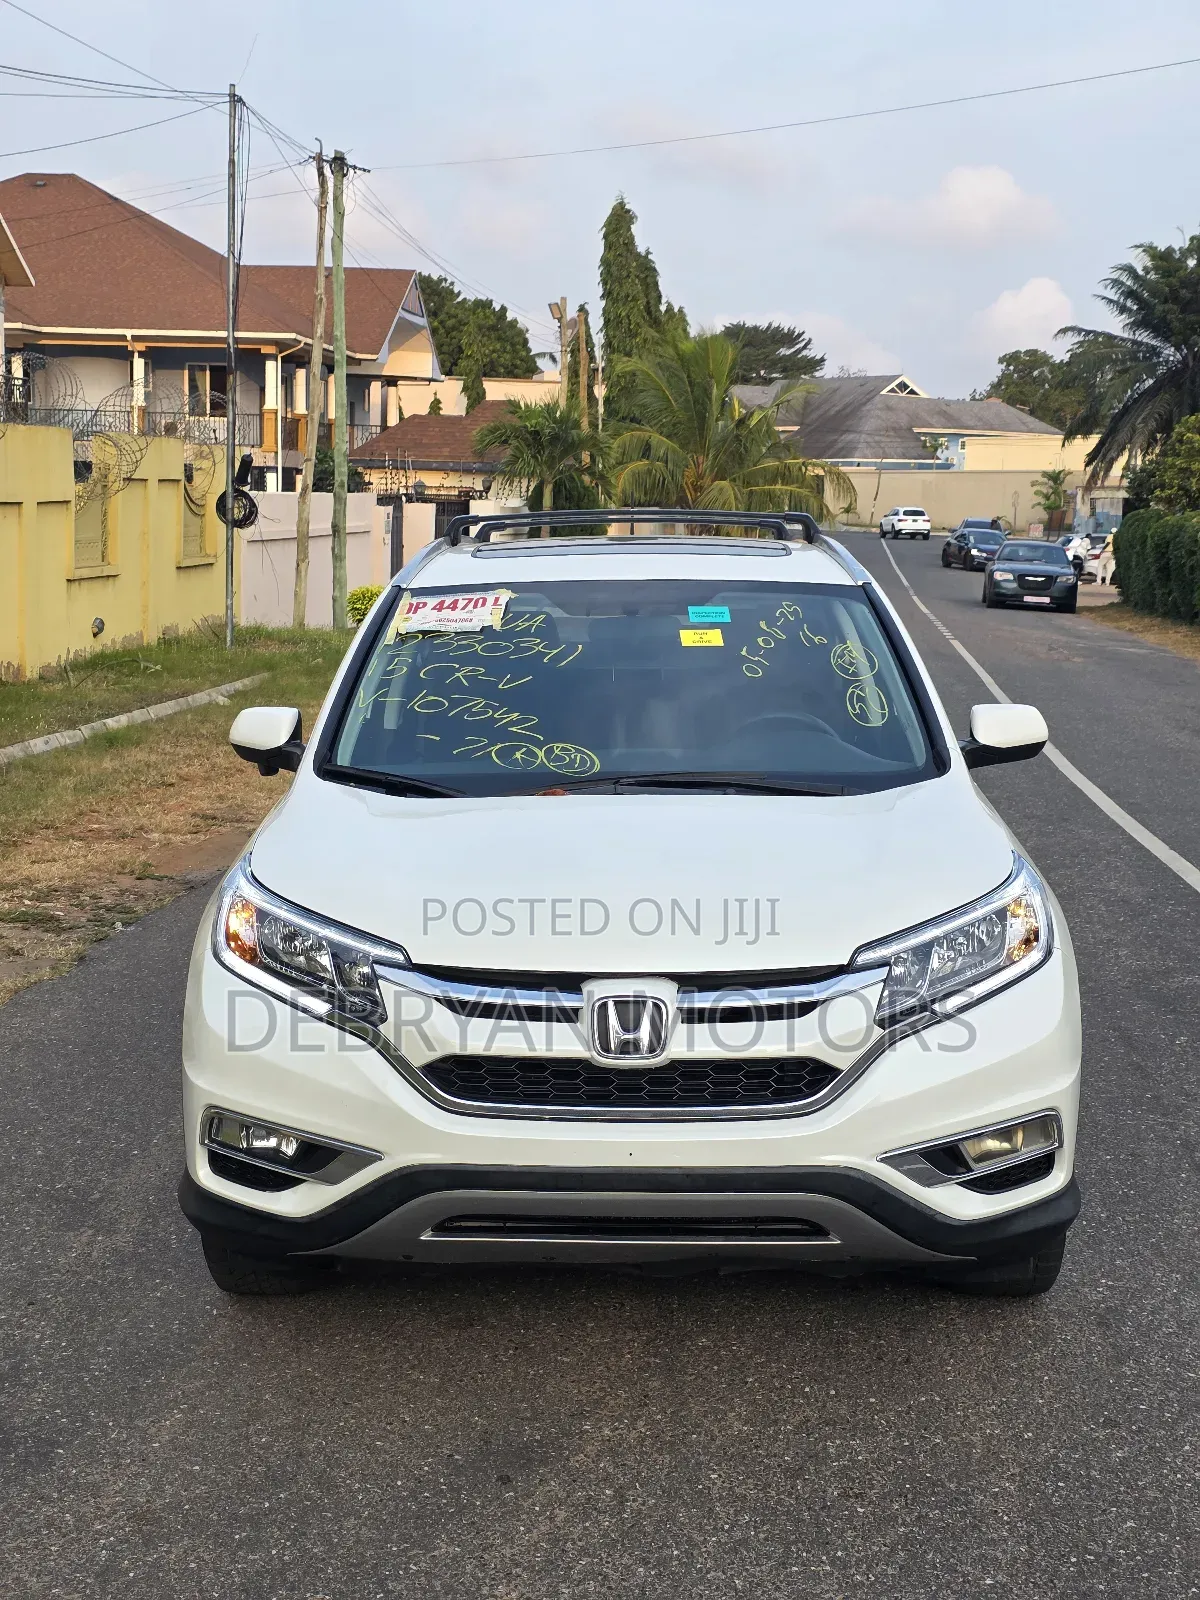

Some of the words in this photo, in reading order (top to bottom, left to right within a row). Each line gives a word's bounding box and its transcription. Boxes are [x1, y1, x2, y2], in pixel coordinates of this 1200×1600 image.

[431, 596, 488, 613] 4470
[491, 596, 503, 607] L
[419, 663, 534, 690] CR-V
